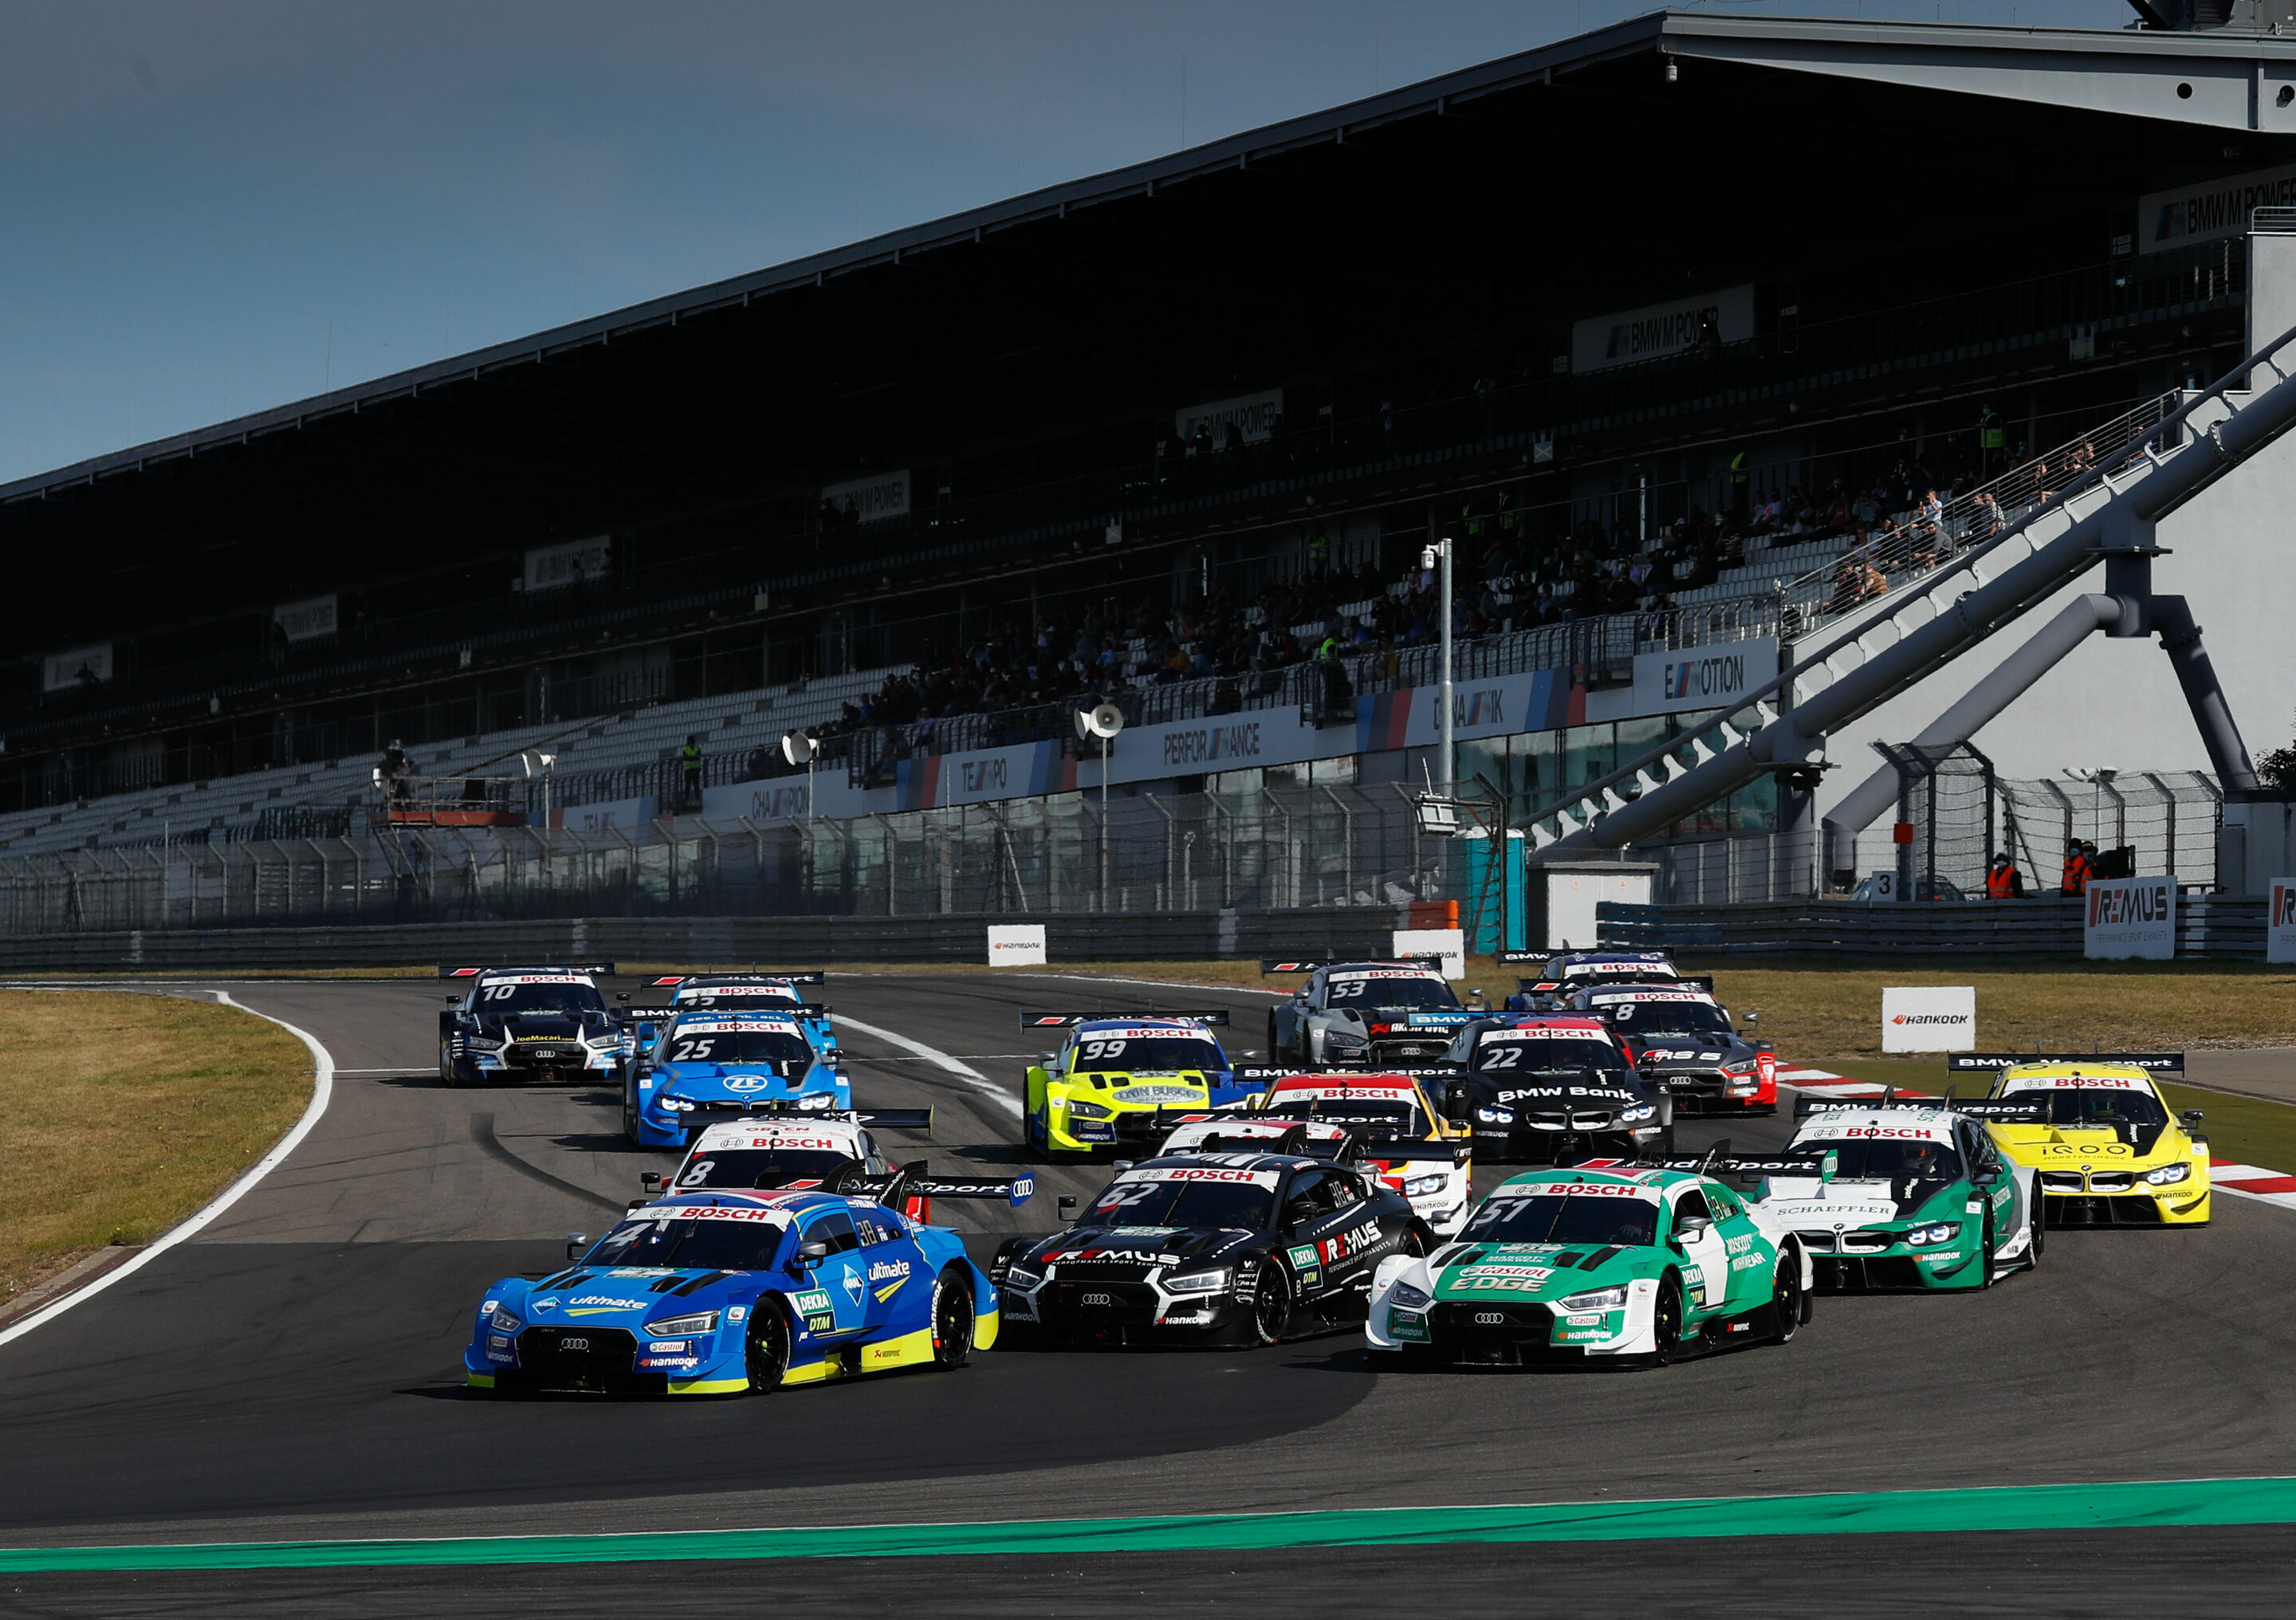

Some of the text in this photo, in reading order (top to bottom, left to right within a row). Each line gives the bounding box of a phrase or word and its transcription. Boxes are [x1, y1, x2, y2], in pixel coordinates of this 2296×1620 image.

[2188, 192, 2225, 234] BMW
[2228, 188, 2241, 226] M
[1632, 317, 1662, 353] BMW
[1664, 315, 1674, 348] M
[1878, 874, 1890, 895] 3
[2097, 886, 2168, 926] REMUS
[483, 985, 516, 1001] 10
[1331, 981, 1366, 999] 53
[671, 1039, 716, 1061] 25
[1083, 1040, 1126, 1060] 99
[1480, 1047, 1523, 1071] 22
[1244, 1068, 1306, 1077] BMW
[730, 1077, 761, 1088] ZF
[2054, 1079, 2131, 1088] BOSCH
[1324, 1088, 1398, 1098] BOSCH
[1497, 1087, 1636, 1103] BMW Bank
[1808, 1103, 1870, 1112] BMW
[1846, 1127, 1932, 1138] BOSCH
[753, 1138, 832, 1149] BOSCH
[681, 1161, 716, 1186] 8
[1169, 1170, 1255, 1182] BOSCH
[1096, 1183, 1160, 1208] 62
[1547, 1184, 1637, 1196] BOSCH
[679, 1208, 769, 1221] BOSCH
[1469, 1198, 1533, 1232] 51
[1777, 1205, 1891, 1217] SCHAEFFLER
[604, 1222, 654, 1247] 4
[1326, 1220, 1382, 1262] REMUS
[1054, 1249, 1181, 1265] REMUS
[1294, 1248, 1317, 1265] DEKRA
[868, 1260, 910, 1281] ultimate
[1303, 1272, 1317, 1284] DTM
[1480, 1266, 1547, 1277] Castrol
[1681, 1267, 1704, 1285] DEKRA
[846, 1276, 862, 1289] ARAL
[1448, 1276, 1548, 1293] EDGE
[568, 1296, 648, 1309] ultimate
[800, 1294, 830, 1311] DEKRA
[808, 1315, 831, 1331] DTM
[1575, 1315, 1598, 1325] Castrol
[658, 1342, 682, 1351] Castrol
